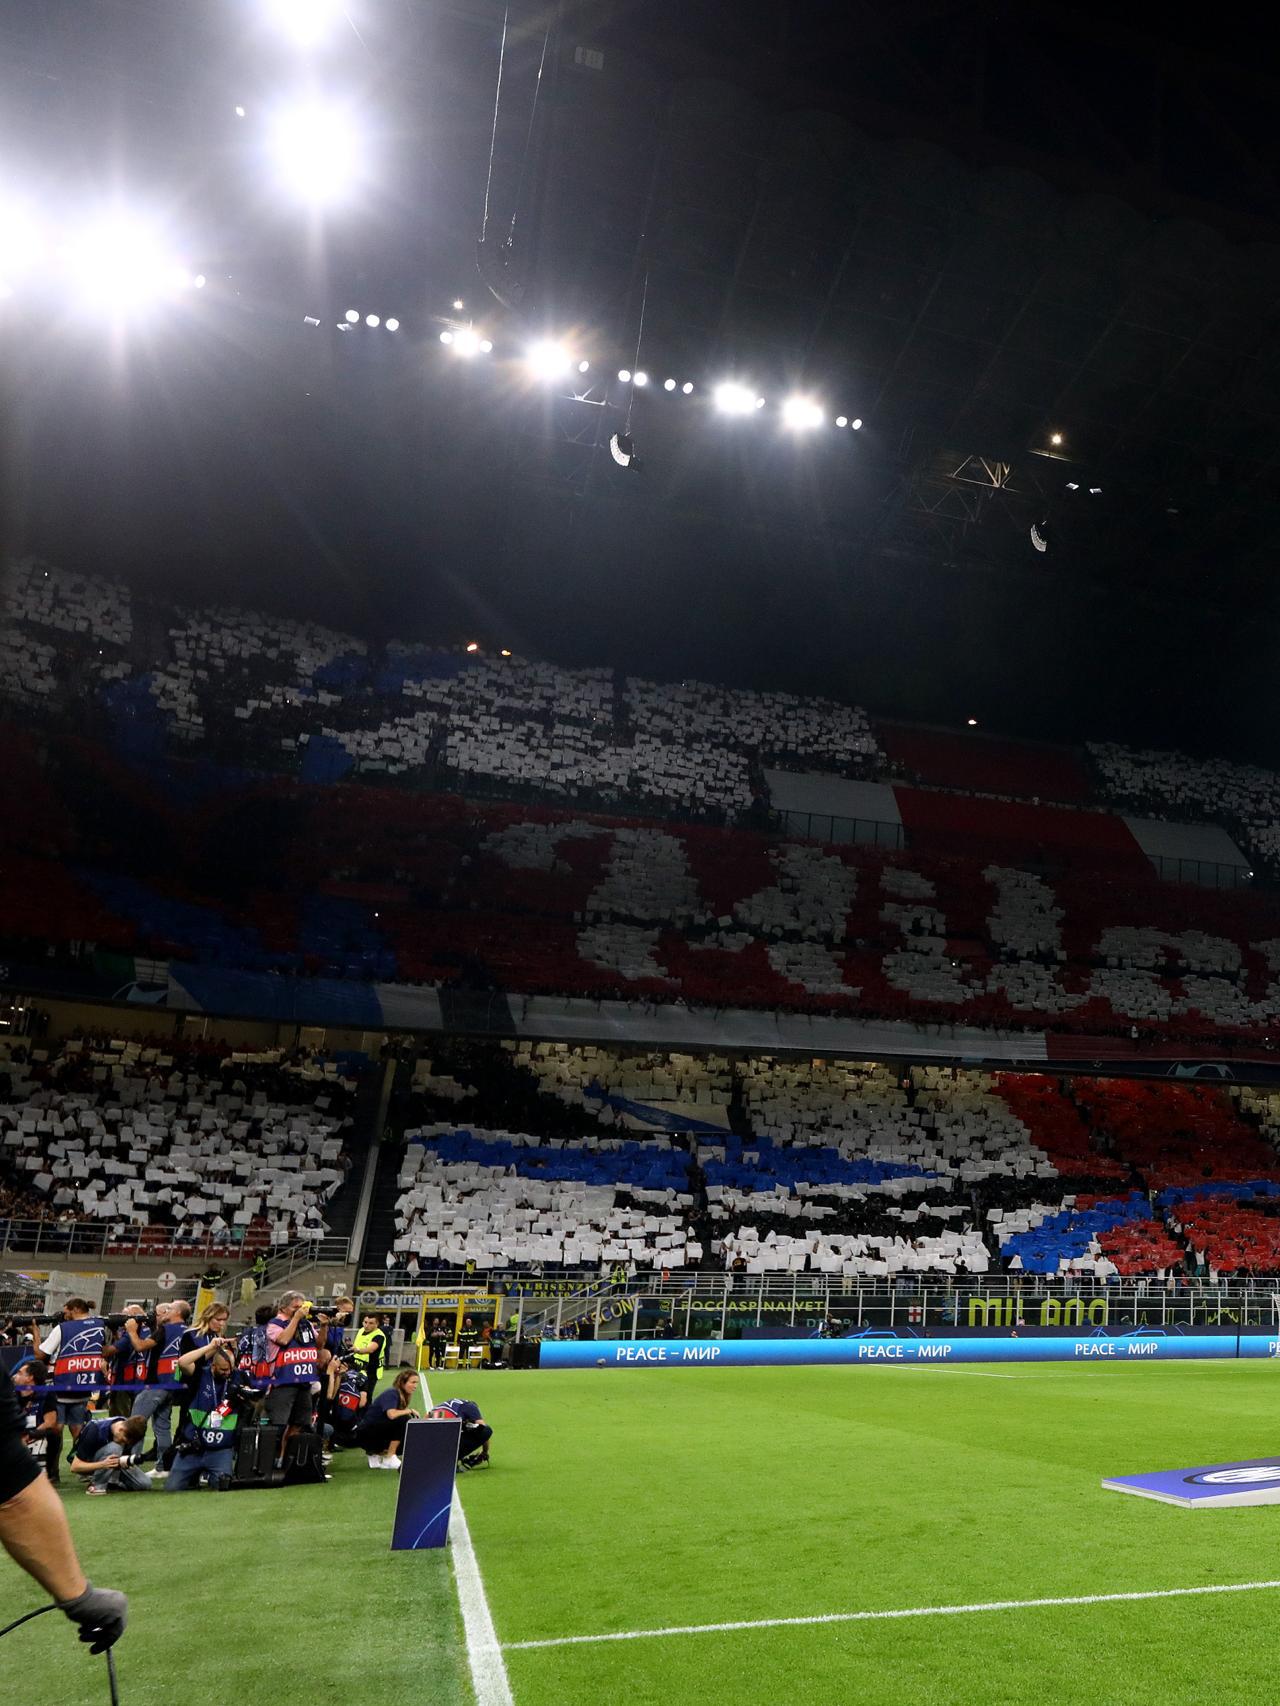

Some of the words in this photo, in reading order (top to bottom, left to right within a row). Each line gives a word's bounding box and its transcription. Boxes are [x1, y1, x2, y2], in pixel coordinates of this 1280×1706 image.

[617, 1347, 666, 1361] PEACE
[683, 1347, 721, 1360] МИР
[858, 1345, 904, 1358] PEACE
[918, 1345, 952, 1357] МИР
[1075, 1344, 1116, 1355] PEACE
[1128, 1343, 1158, 1355] МИР
[283, 1349, 318, 1363] PHOTO
[294, 1363, 313, 1376] 020
